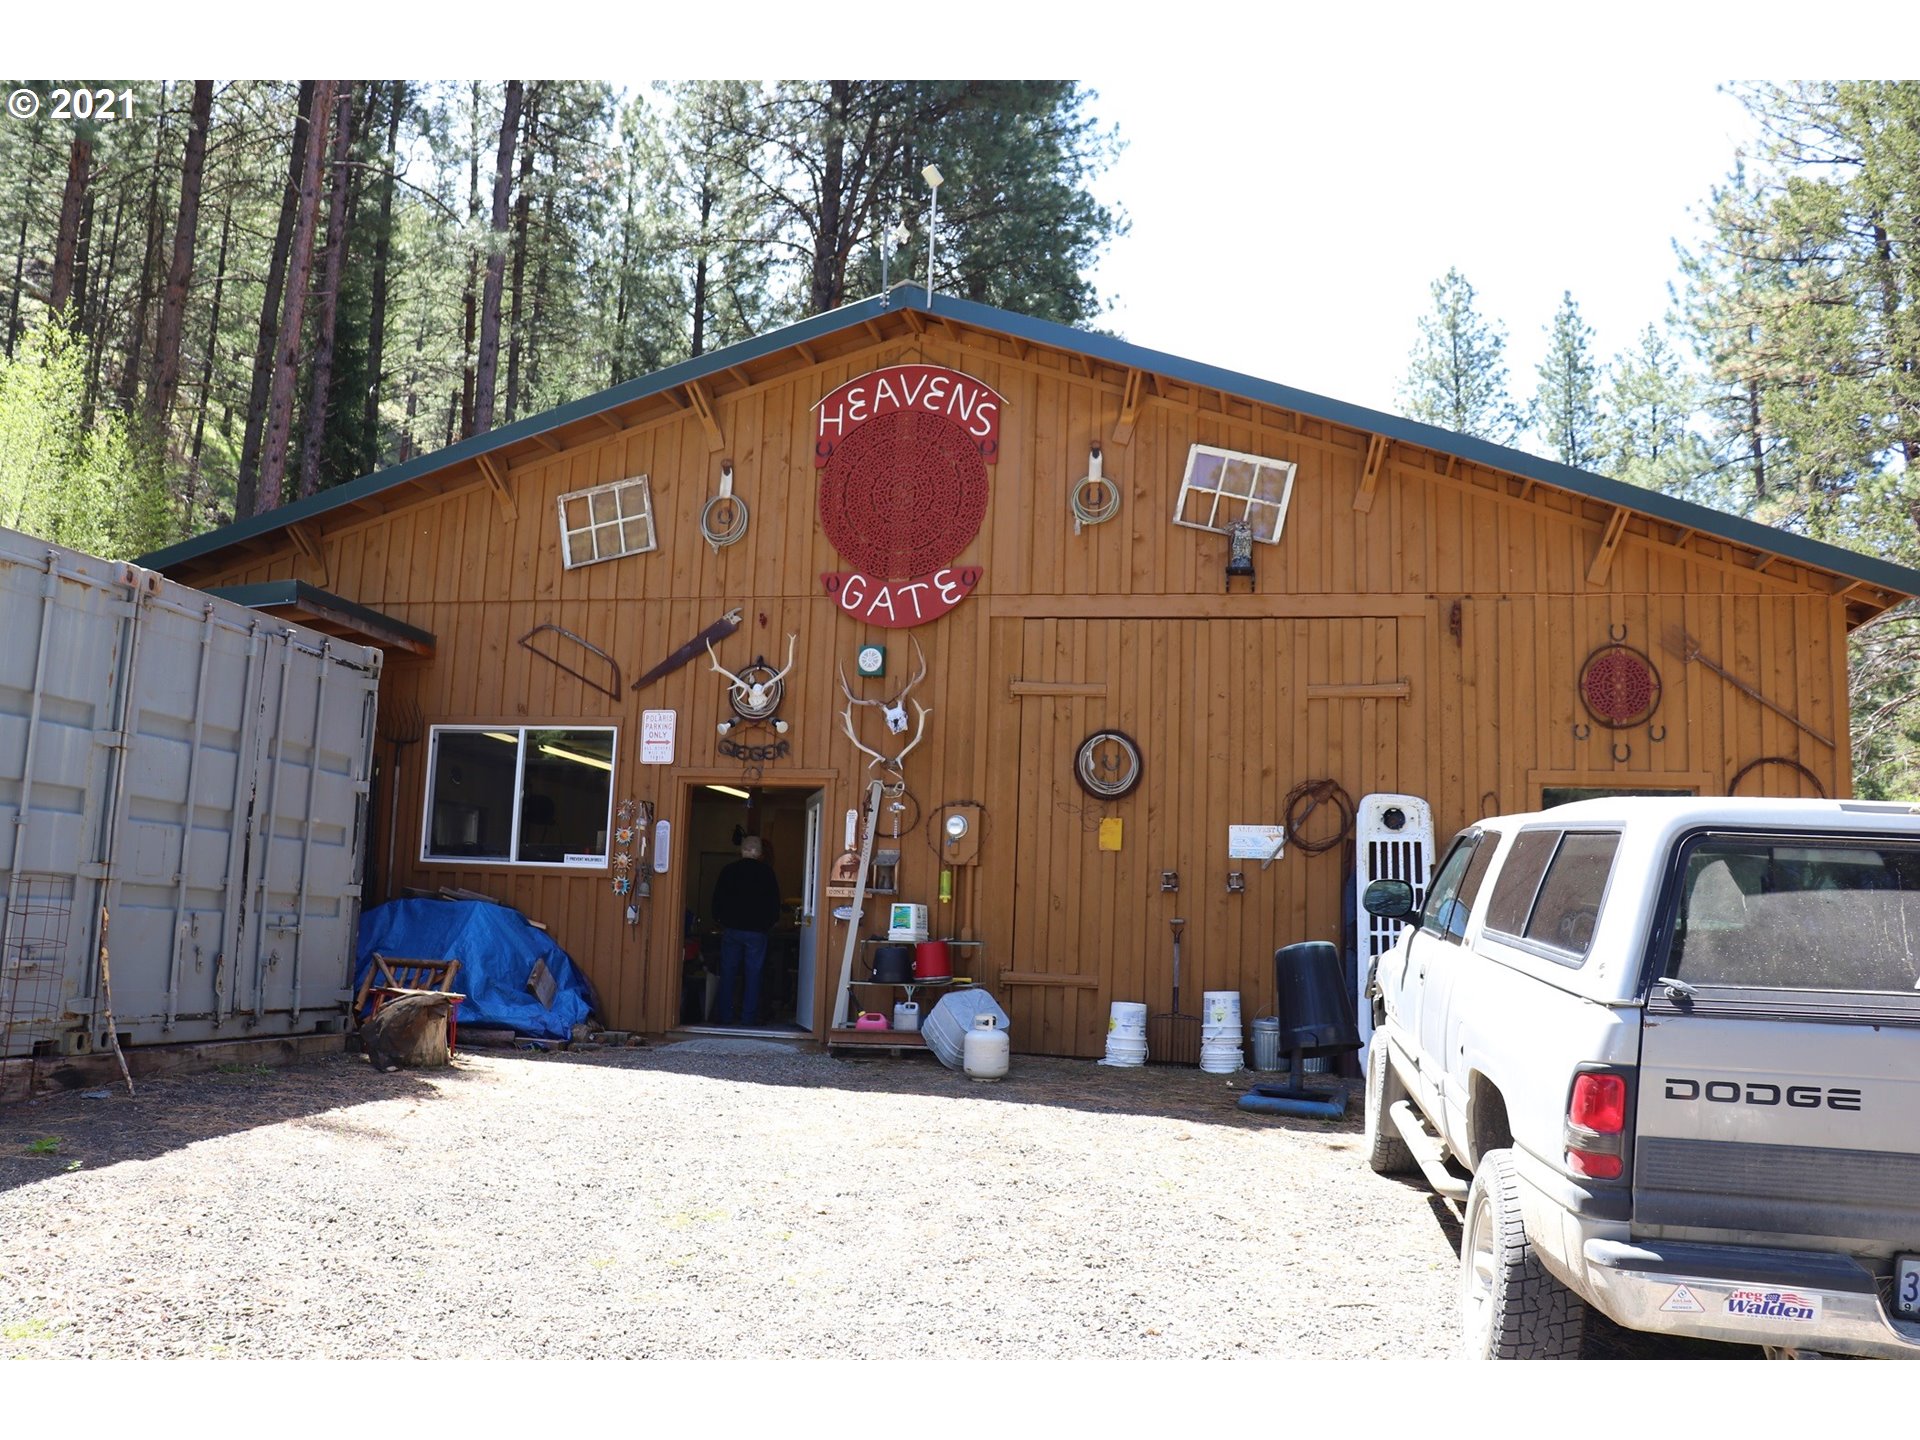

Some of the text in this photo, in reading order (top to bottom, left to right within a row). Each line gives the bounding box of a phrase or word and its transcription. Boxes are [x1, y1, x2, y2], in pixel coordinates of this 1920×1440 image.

[819, 373, 997, 437] HEAVEN'S
[841, 569, 962, 621] GATE
[645, 714, 673, 722] POLARIS
[645, 723, 673, 731] PARKING
[648, 731, 667, 739] ONLY
[1665, 1078, 1861, 1111] DODGE
[1729, 1289, 1763, 1303] Greg
[1728, 1299, 1815, 1320] Walden
[1904, 1303, 1912, 1312] 9
